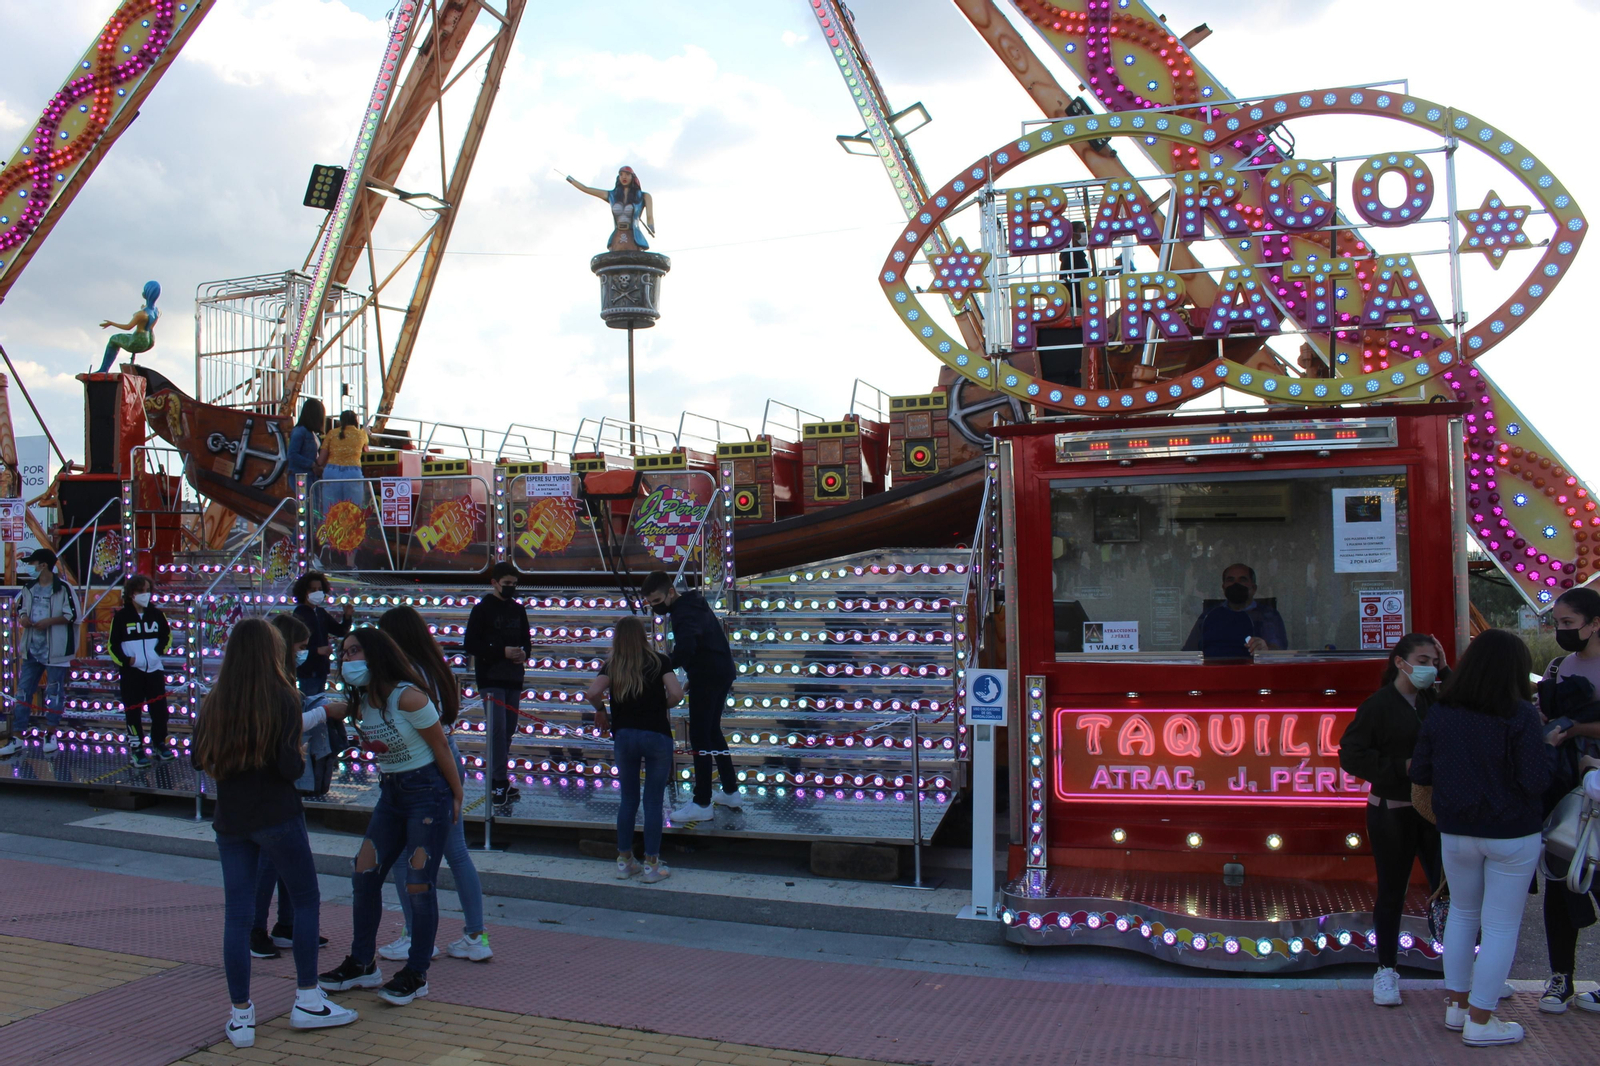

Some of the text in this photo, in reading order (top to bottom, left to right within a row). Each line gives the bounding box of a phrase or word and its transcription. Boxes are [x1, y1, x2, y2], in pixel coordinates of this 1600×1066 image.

[1006, 152, 1434, 252] BARCO
[1011, 253, 1437, 350] PIRATA
[23, 465, 44, 474] POR
[126, 620, 159, 635] FILA
[1076, 713, 1342, 758] TAQUILL
[1270, 757, 1372, 793] PÉRE
